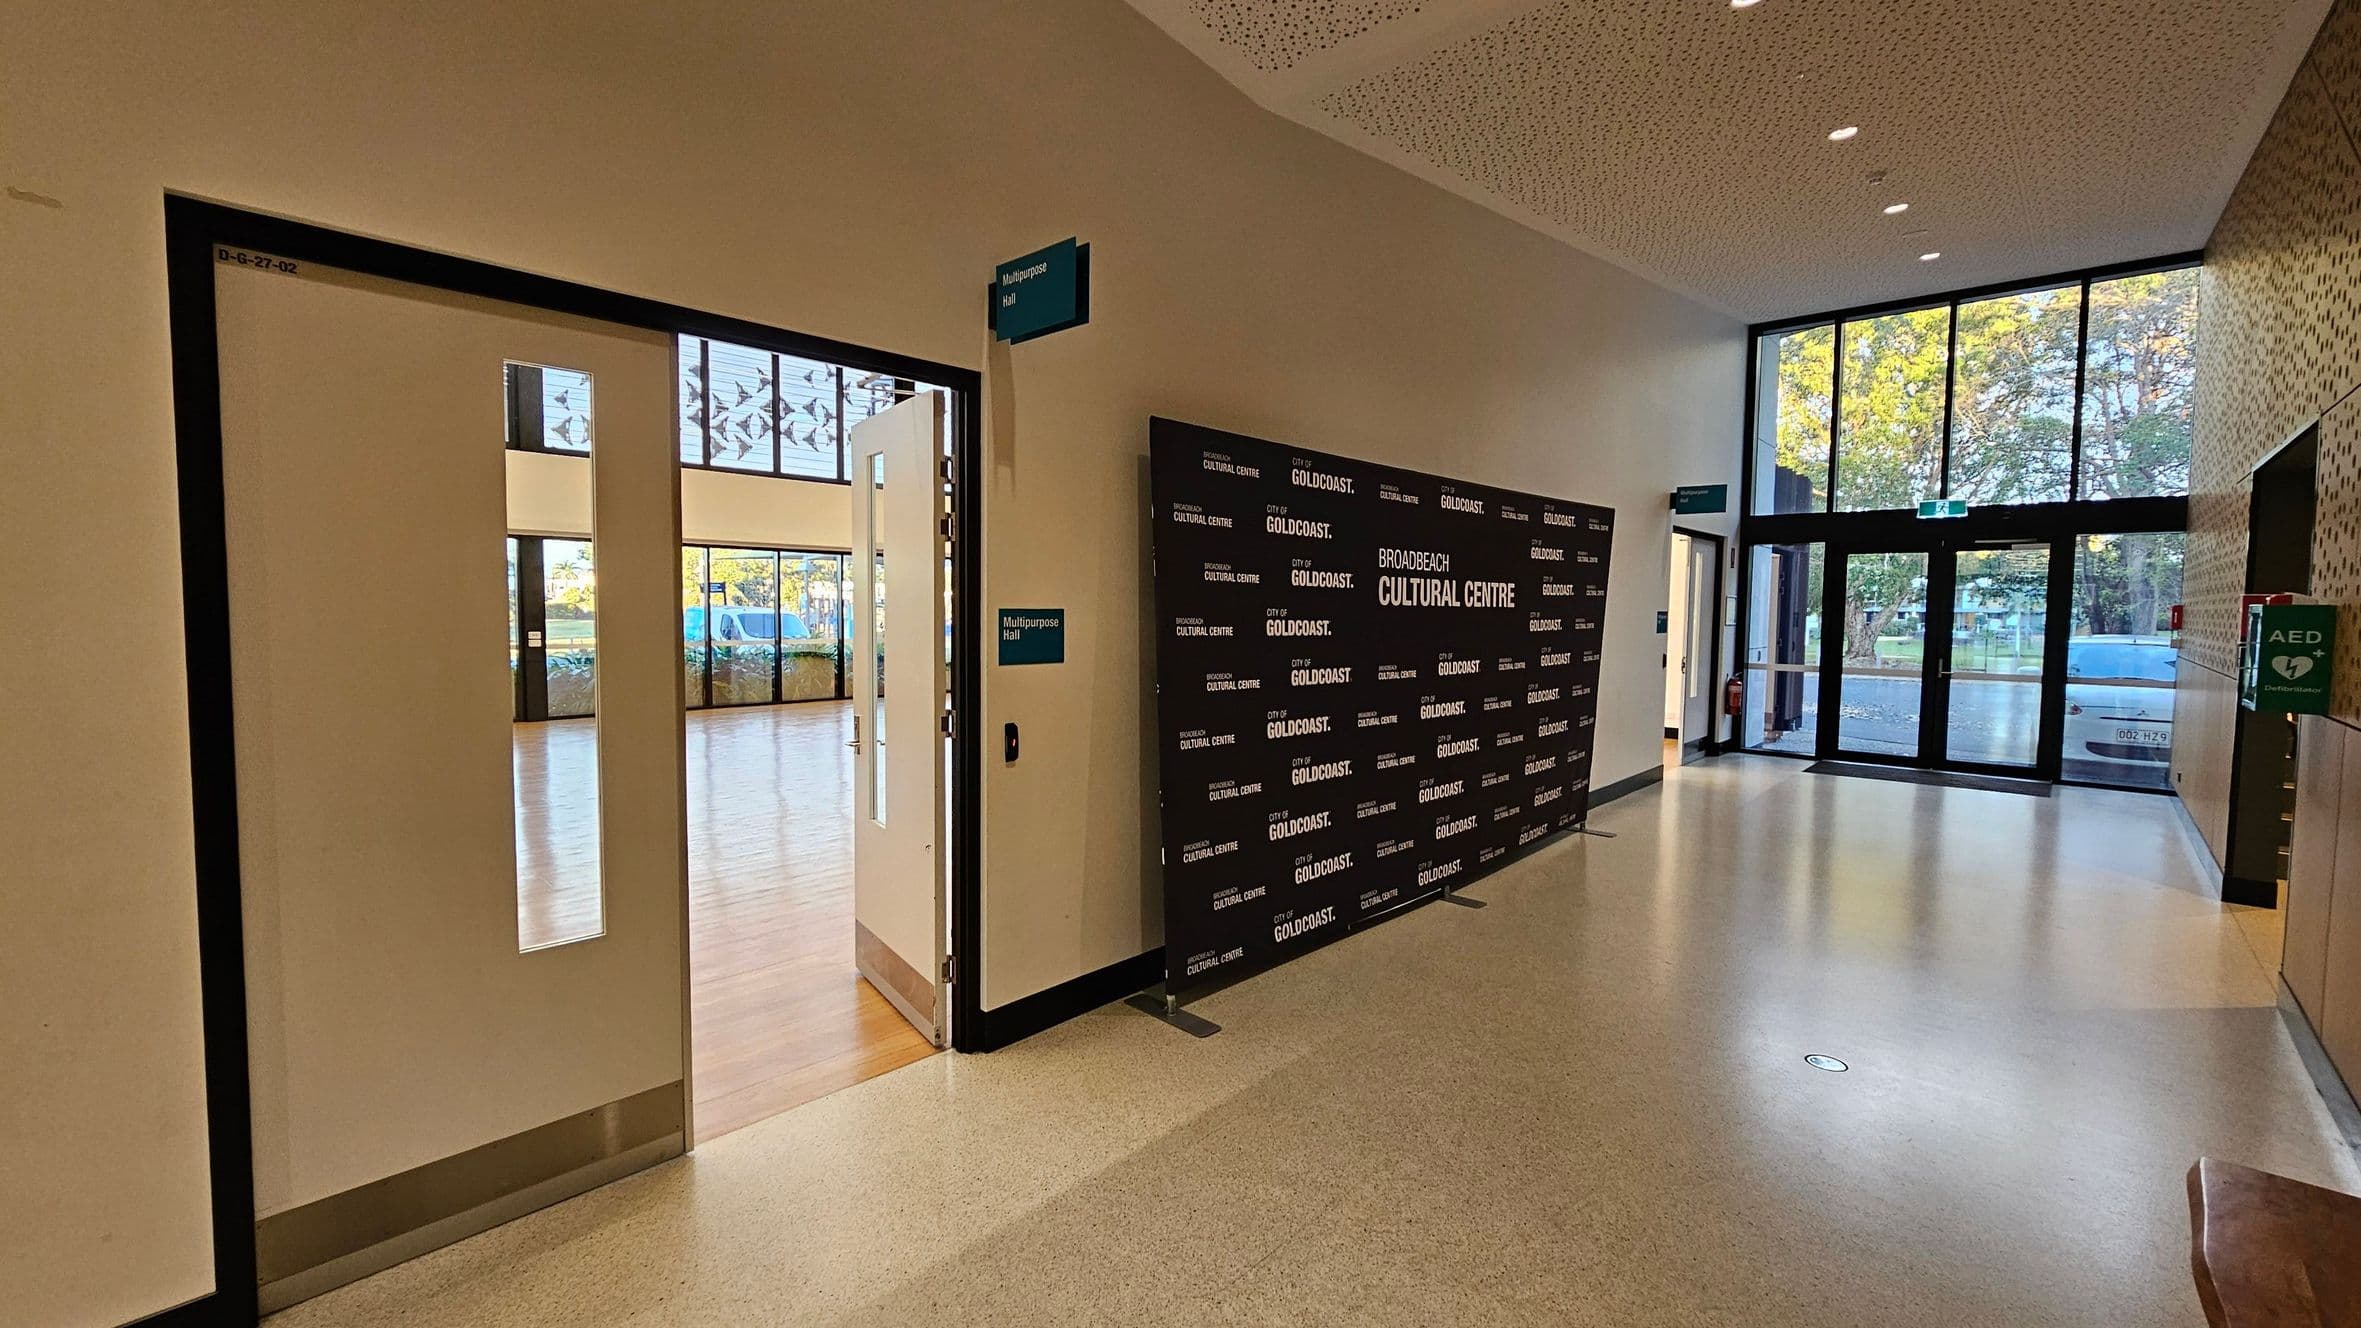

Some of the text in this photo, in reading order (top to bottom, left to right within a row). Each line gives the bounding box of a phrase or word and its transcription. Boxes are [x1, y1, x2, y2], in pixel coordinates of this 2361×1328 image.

[219, 248, 297, 275] D-G-27-02
[1002, 262, 1047, 287] Multipurpose
[1002, 292, 1016, 308] Hall
[1203, 459, 1260, 479] CULTURAL CENTRE
[1292, 457, 1312, 468] CITY OF
[1292, 468, 1355, 494] GOLDCOAST.
[1379, 490, 1419, 505] CULTURAL CENTRE
[1440, 494, 1485, 515] GOLDCOAST.
[1266, 504, 1288, 515] CITY OF
[1173, 511, 1233, 528] CULTURAL CENTRE
[1266, 515, 1332, 539] GOLDCOAST.
[1292, 558, 1312, 568] CITY OF
[1379, 547, 1450, 573] BROADBEACH
[1204, 570, 1260, 584] CULTURAL CENTRE
[1291, 569, 1354, 589] GOLDCOAST.
[1378, 575, 1515, 608] CULTURAL CENTRE
[1266, 608, 1287, 617] CITY OF
[1003, 616, 1059, 629] Multipurpose
[1176, 626, 1234, 637] CULTURAL CENTRE
[1266, 619, 1332, 637] GOLDCOAST.
[1003, 629, 1020, 641] Hall
[2268, 630, 2322, 644] AED
[1291, 658, 1311, 668] CITY OF
[1378, 669, 1417, 680] CULTURAL CENTRE
[1206, 679, 1261, 692] CULTURAL CENTRE
[2264, 685, 2322, 693] Defibrillator
[1267, 709, 1287, 720] CITY OF
[1420, 700, 1466, 720] GOLDCOAST.
[1267, 716, 1331, 739] GOLDCOAST.
[1357, 714, 1398, 728] CULTURAL CENTRE
[1180, 734, 1236, 751] CULTURAL CENTRE
[1437, 737, 1480, 759] GOLDCOAST.
[1292, 756, 1311, 767] CITY OF
[1377, 755, 1416, 770] CULTURAL CENTRE
[1291, 760, 1353, 786] GOLDCOAST.
[1209, 782, 1262, 802] CULTURAL CENTRE
[1418, 780, 1465, 804] GOLDCOAST.
[1268, 810, 1289, 822] CITY OF
[1356, 801, 1397, 819] CULTURAL CENTRE
[1269, 810, 1332, 841] GOLDCOAST.
[1435, 815, 1478, 840] GOLDCOAST.
[1183, 840, 1239, 864] CULTURAL CENTRE
[1376, 839, 1414, 858] CULTURAL CENTRE
[1295, 853, 1313, 866] CITY OF
[1295, 852, 1354, 885] GOLDCOAST.
[1418, 858, 1463, 887] GOLDCOAST.
[1213, 885, 1266, 911] CULTURAL CENTRE
[1360, 888, 1398, 910] CULTURAL CENTRE
[1274, 909, 1293, 924] CITY OF
[1274, 906, 1336, 943] GOLDCOAST.
[1187, 947, 1244, 976] CULTURAL CENTRE
